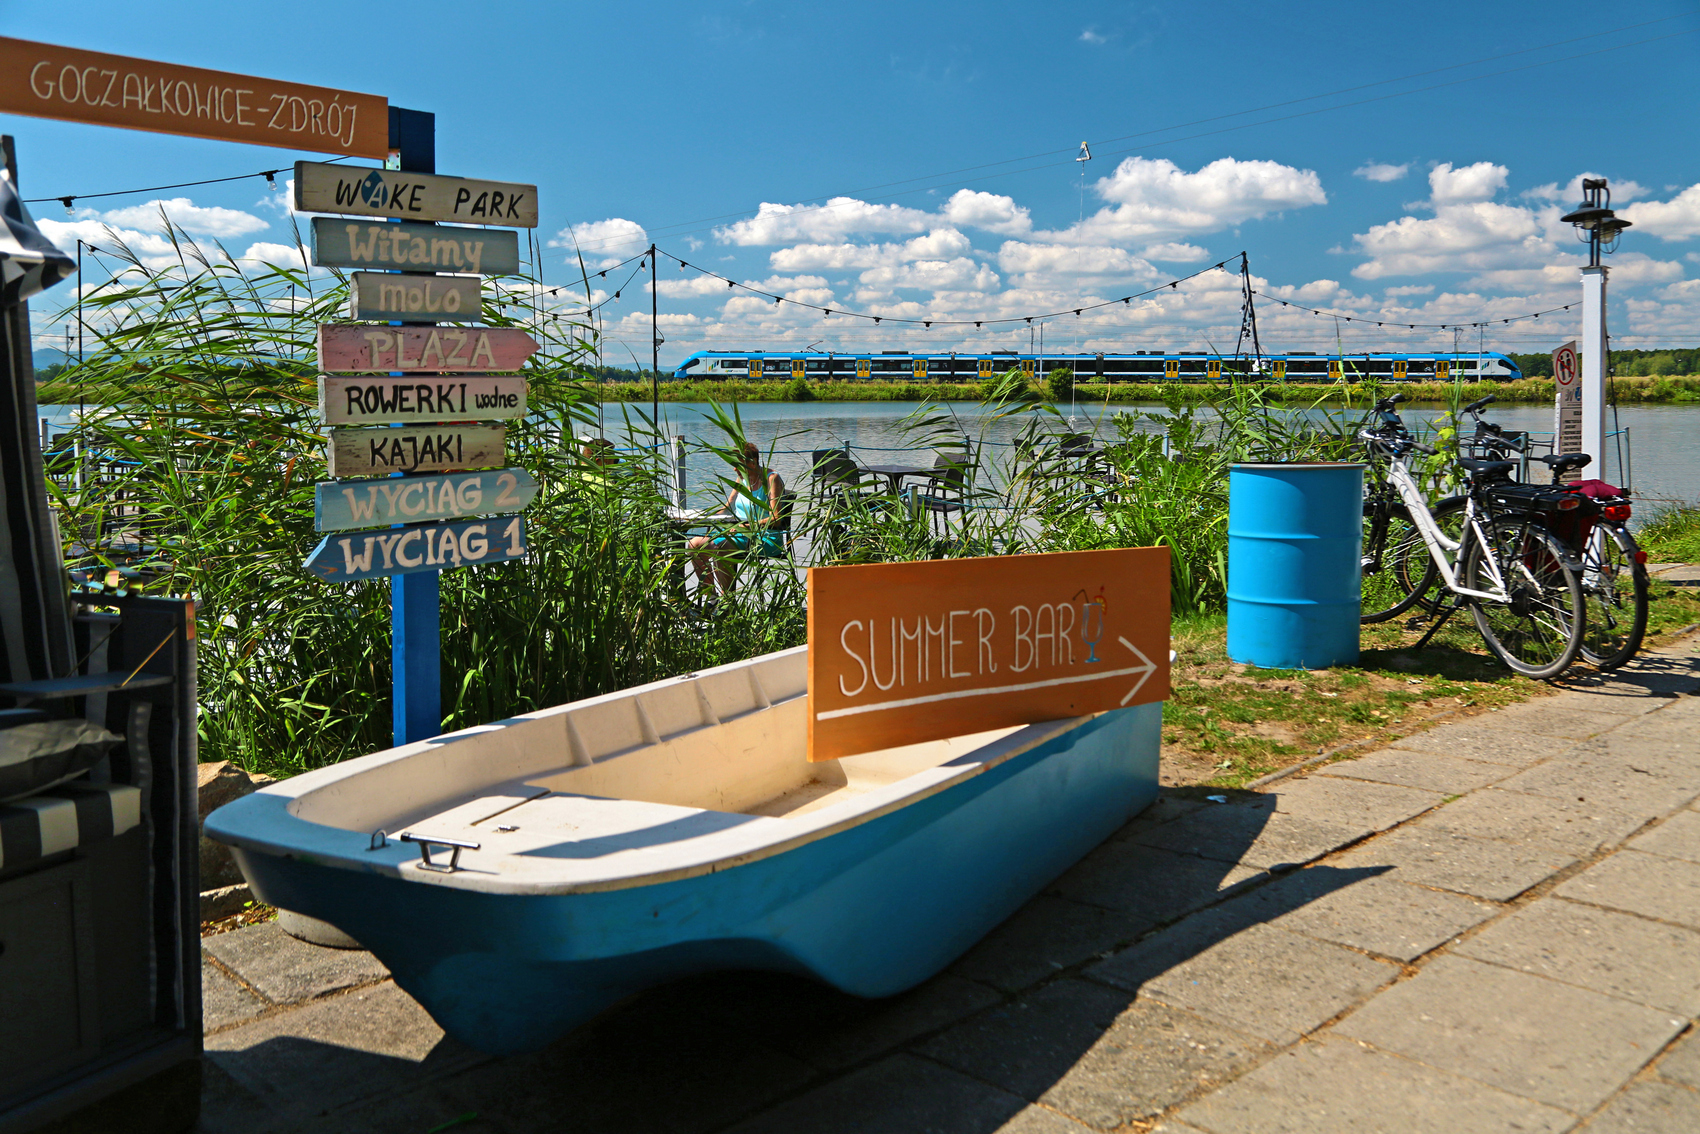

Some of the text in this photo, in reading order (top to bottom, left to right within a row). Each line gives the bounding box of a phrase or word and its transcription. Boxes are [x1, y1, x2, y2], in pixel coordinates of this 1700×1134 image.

[30, 61, 357, 147] GOCZAŁKOWICE-ZDRÓJ
[335, 175, 524, 220] WAKE PARK
[345, 224, 485, 273] Witamy
[345, 383, 519, 415] ROWERKI wodne
[370, 434, 462, 471] KAJAKI
[342, 473, 520, 522] WYCIĄG 2
[338, 517, 525, 575] WYCIĄG 1
[839, 602, 1075, 696] SUMMER BAR
